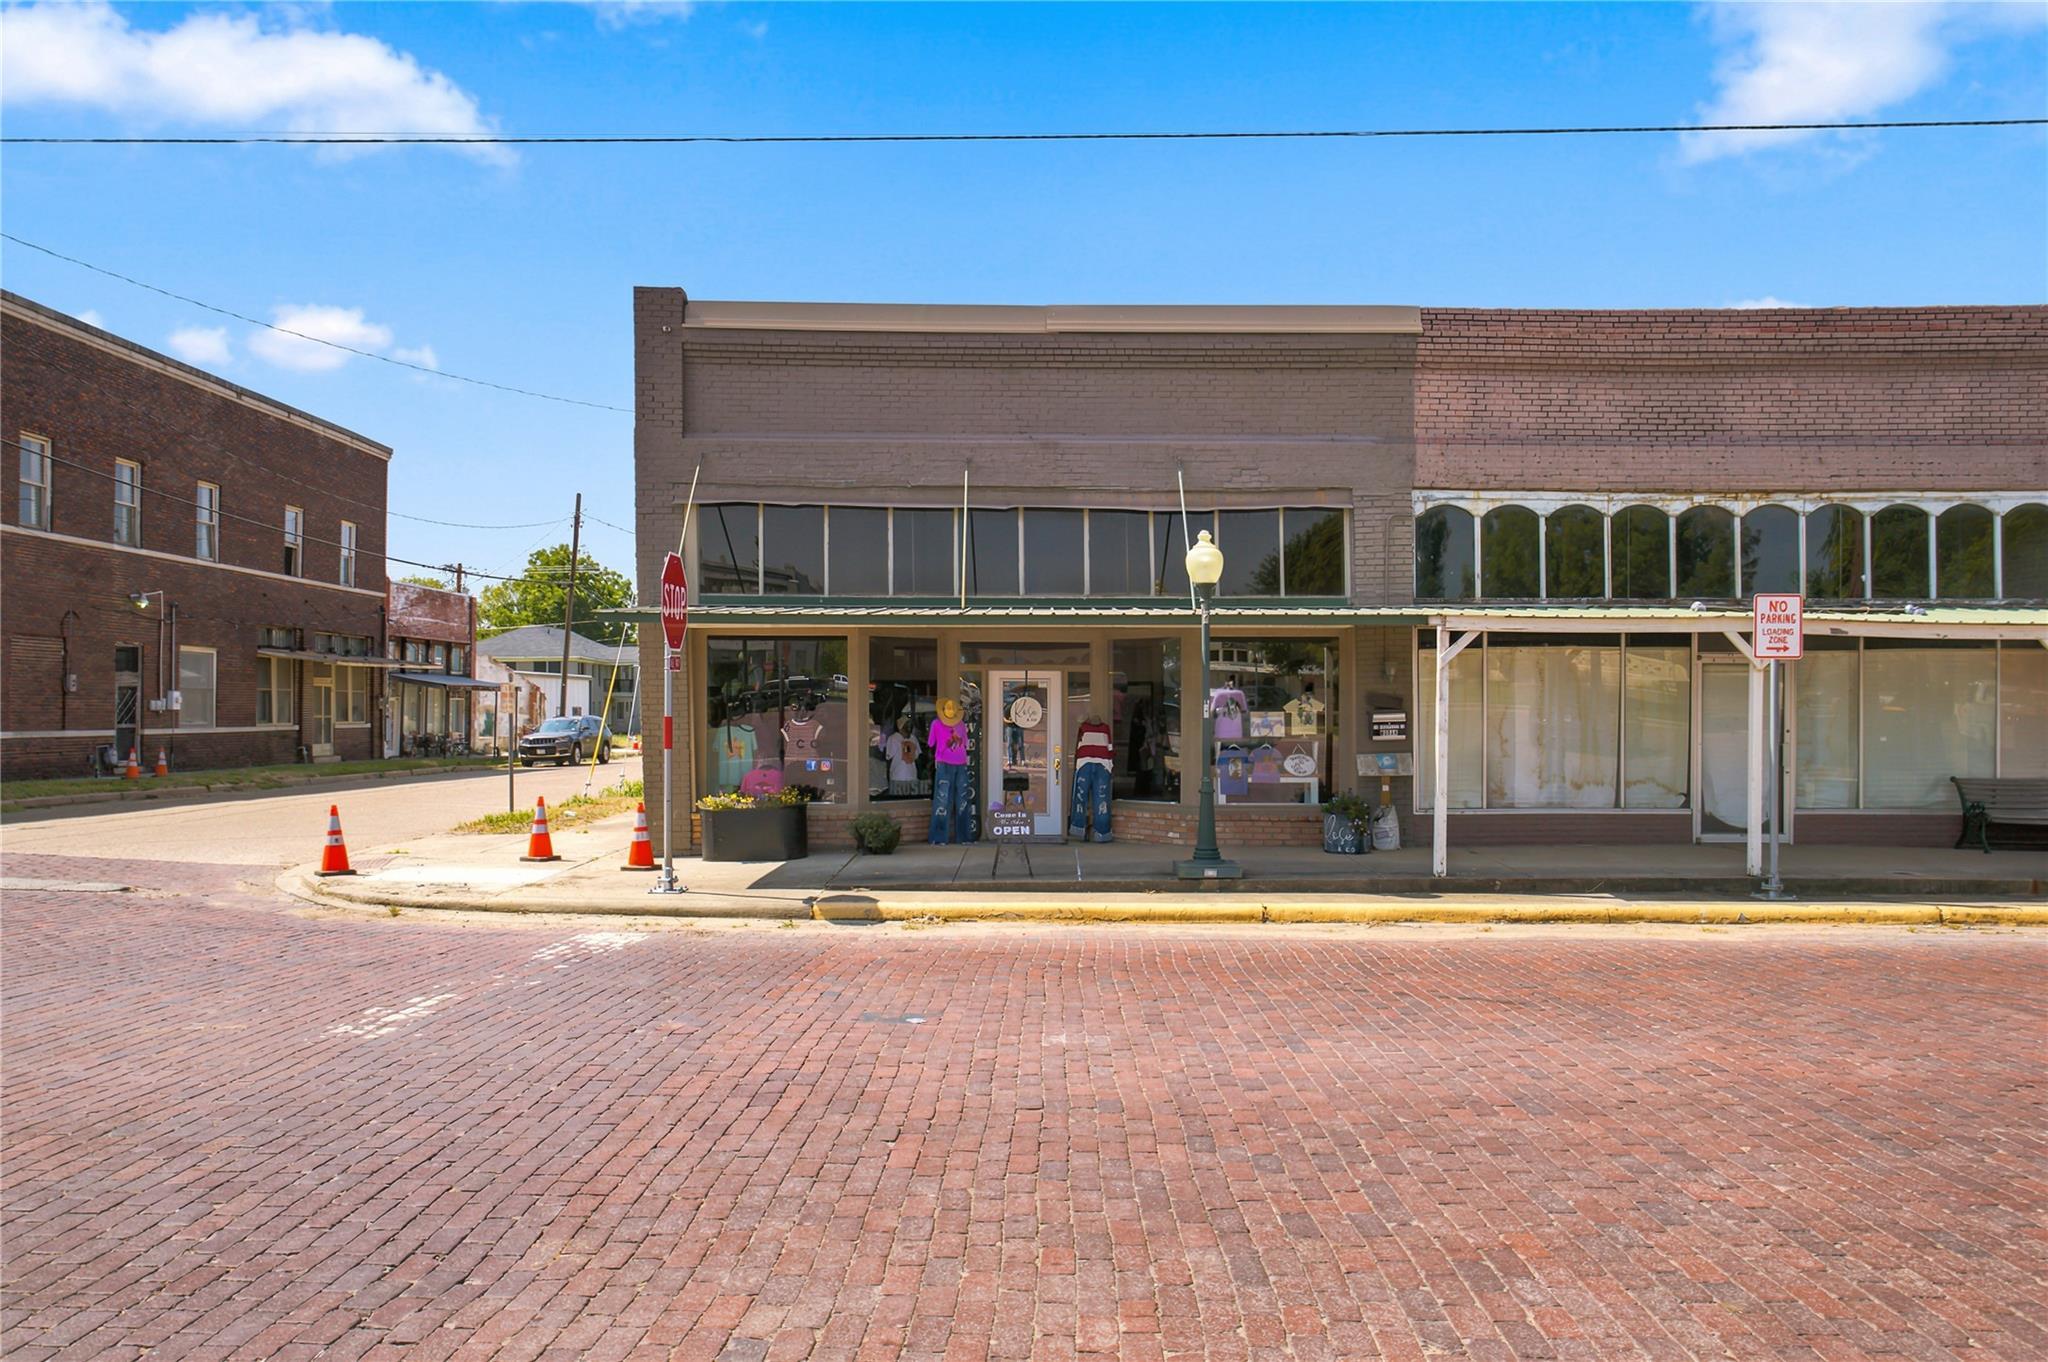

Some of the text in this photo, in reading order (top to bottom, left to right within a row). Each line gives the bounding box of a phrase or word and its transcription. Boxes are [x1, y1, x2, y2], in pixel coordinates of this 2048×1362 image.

[664, 583, 686, 620] STOP
[1769, 600, 1788, 612] NO
[1760, 613, 1796, 624] PARKING
[993, 826, 1030, 835] OPEN
